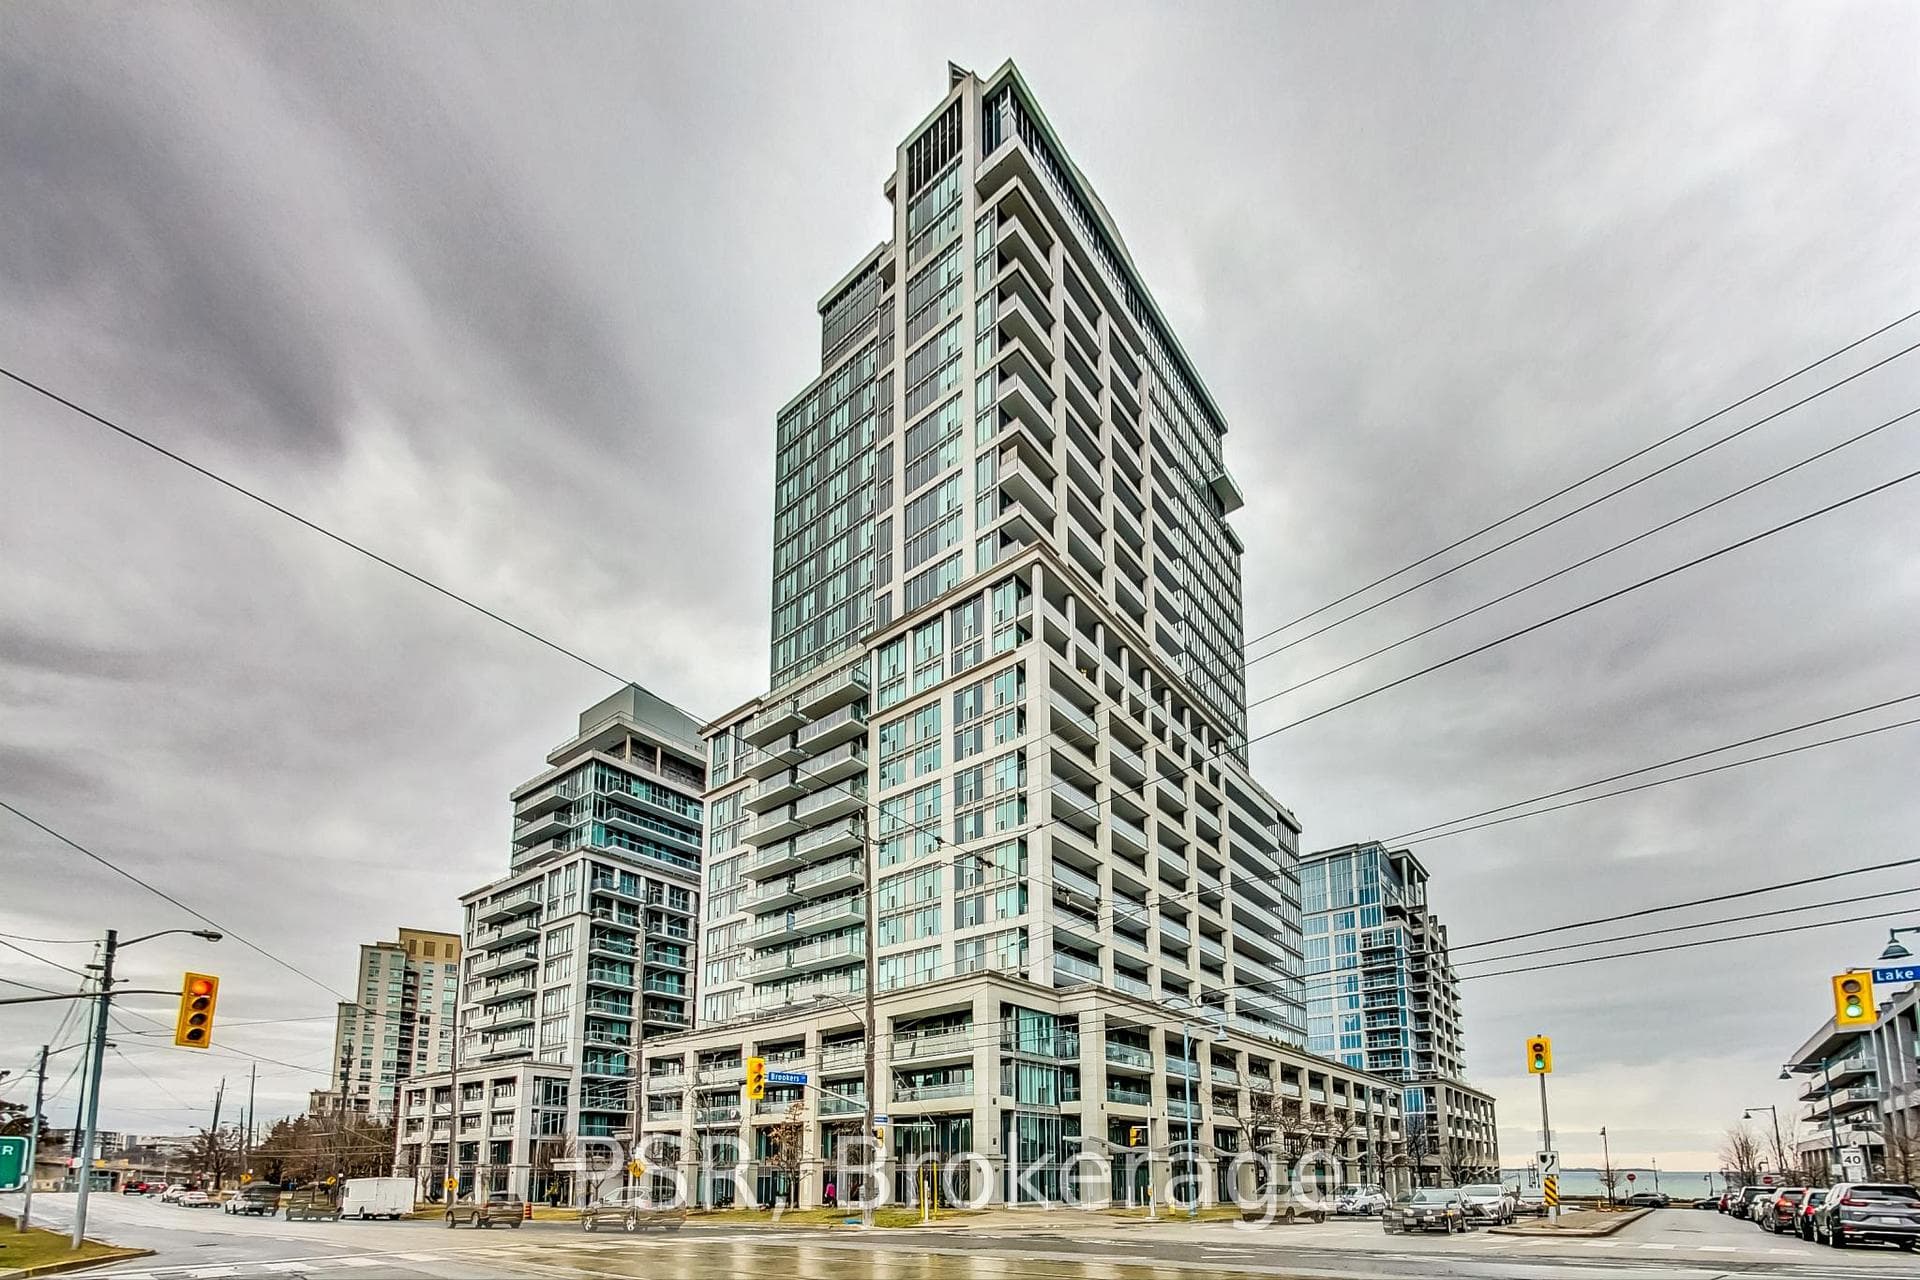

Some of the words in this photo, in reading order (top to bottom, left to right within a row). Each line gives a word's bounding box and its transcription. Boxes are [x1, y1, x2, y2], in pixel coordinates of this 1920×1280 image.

[1876, 970, 1914, 981] Lake
[770, 1073, 799, 1082] Brookers
[1, 1145, 14, 1156] R
[1844, 1155, 1861, 1164] 40
